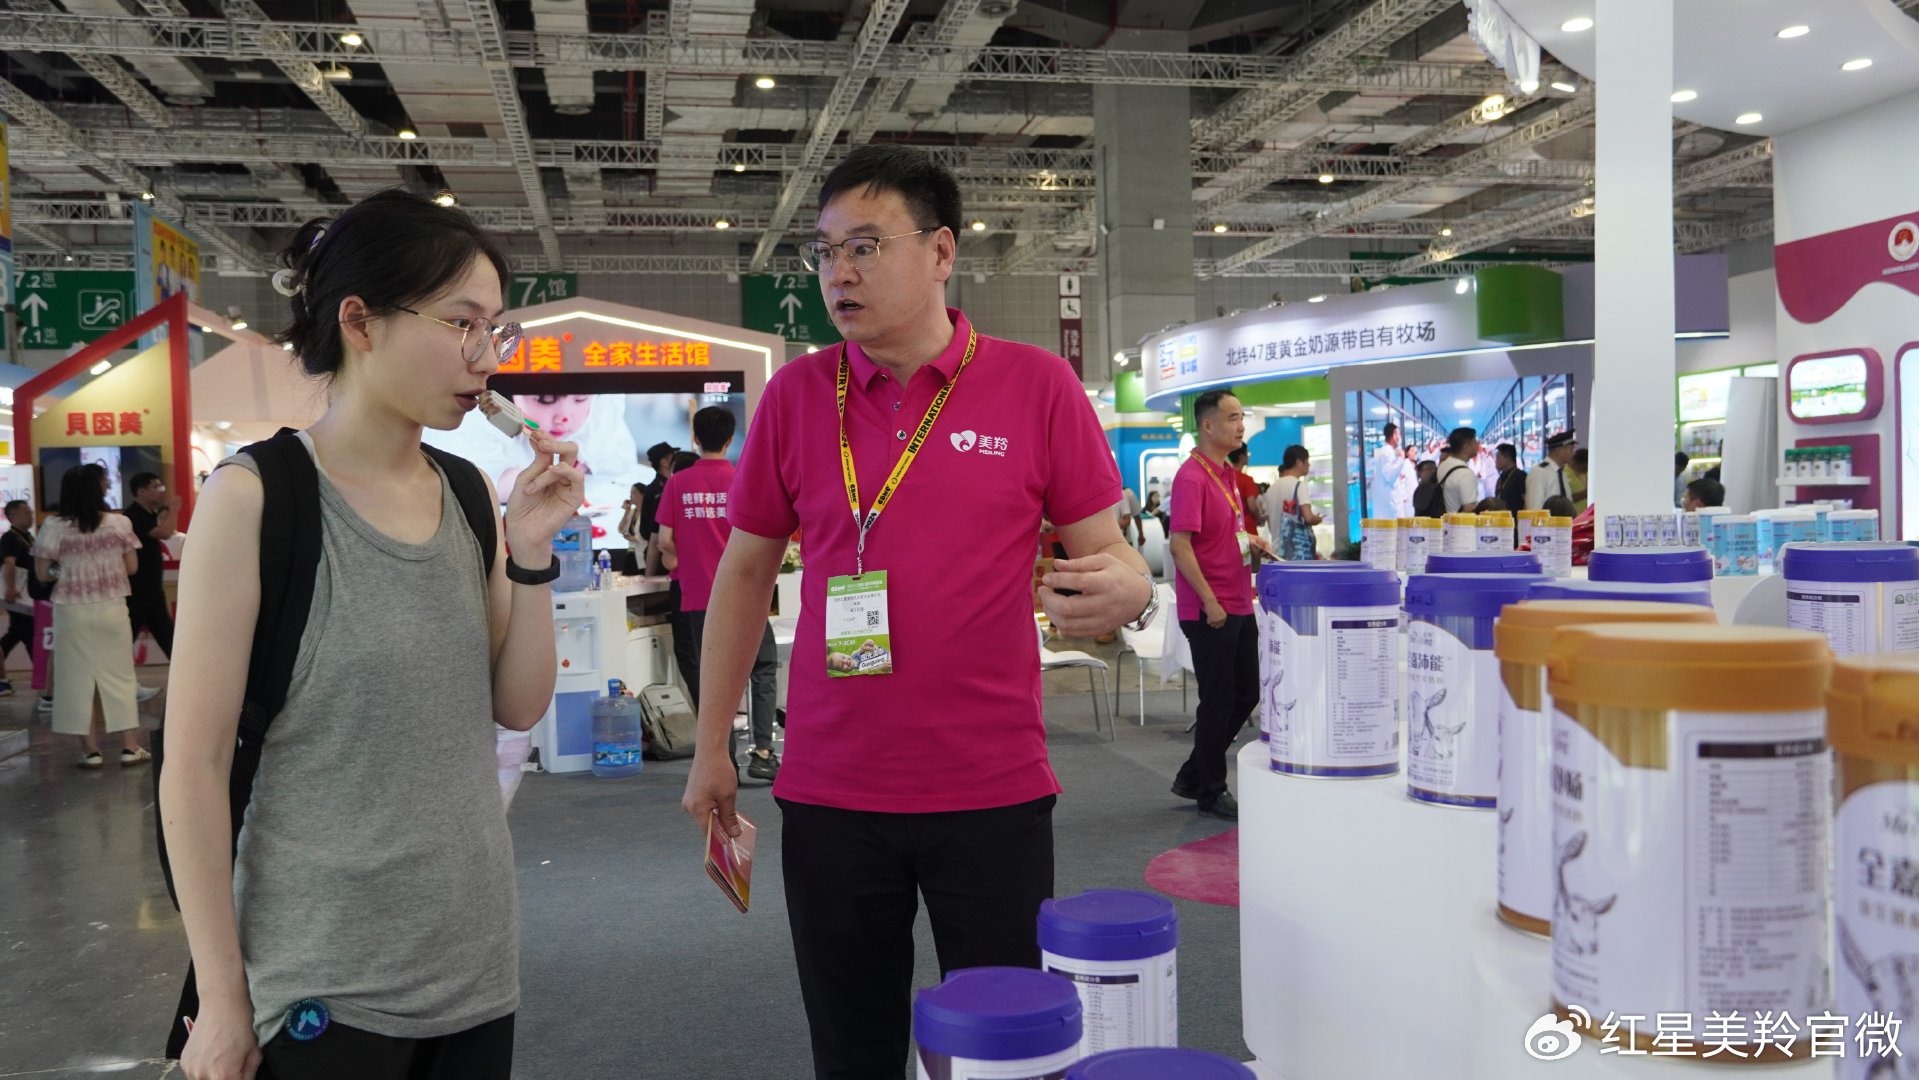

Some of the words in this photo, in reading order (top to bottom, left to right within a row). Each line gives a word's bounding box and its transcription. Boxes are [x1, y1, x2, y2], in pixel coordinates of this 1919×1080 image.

[583, 340, 711, 367] 全家生活馆
[1225, 320, 1436, 367] 北纬47度黄金奶源带自有牧场
[978, 434, 1009, 451] 美羚
[979, 448, 1006, 458] MEILING
